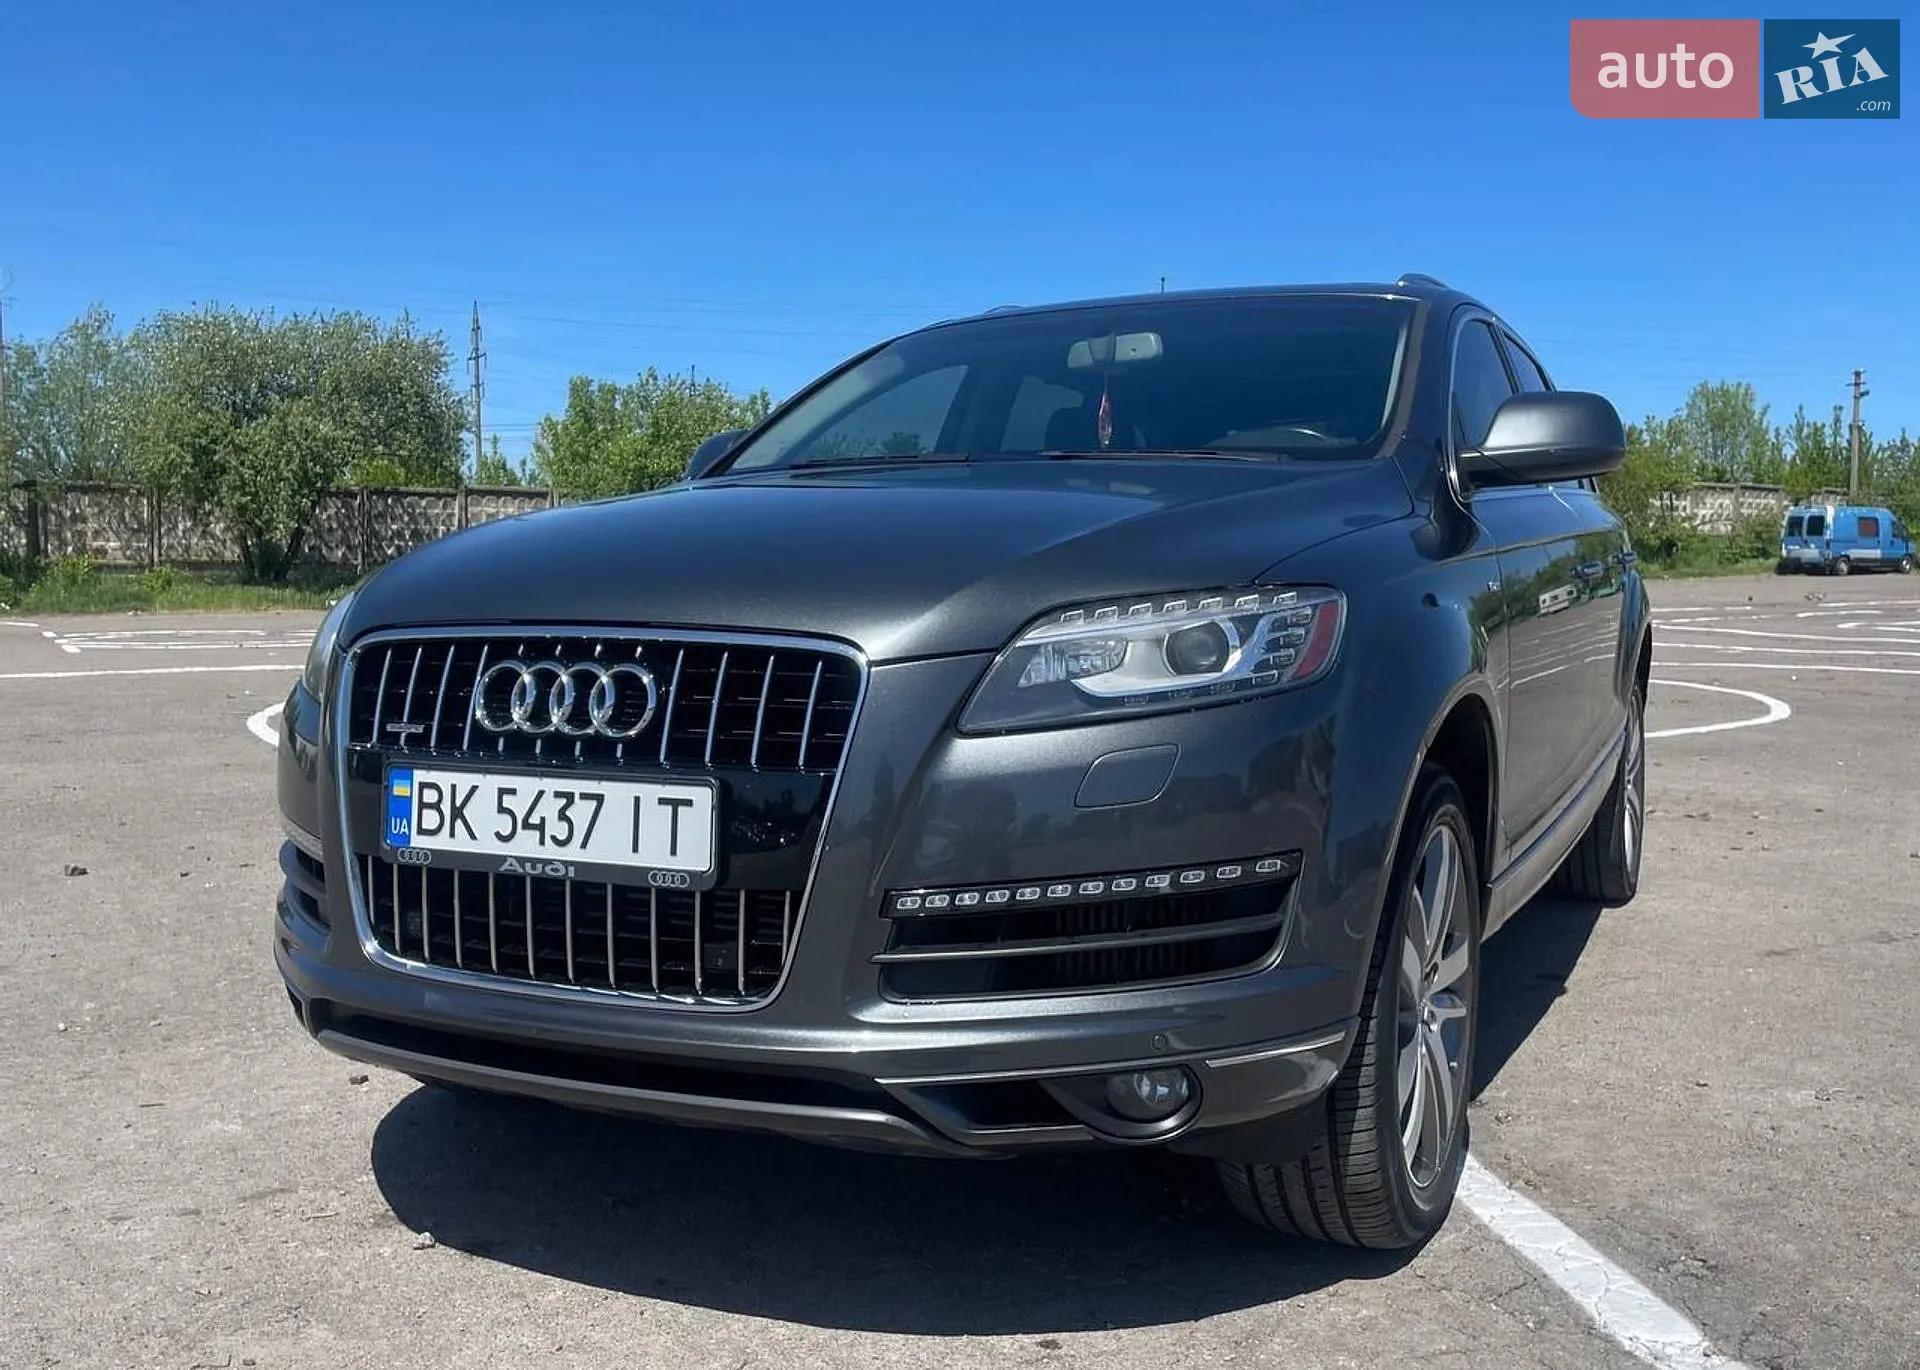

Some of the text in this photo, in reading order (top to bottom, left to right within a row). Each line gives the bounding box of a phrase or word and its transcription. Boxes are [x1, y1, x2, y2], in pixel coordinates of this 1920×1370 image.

[390, 816, 409, 835] UA
[416, 781, 694, 856] BK 5437 IT
